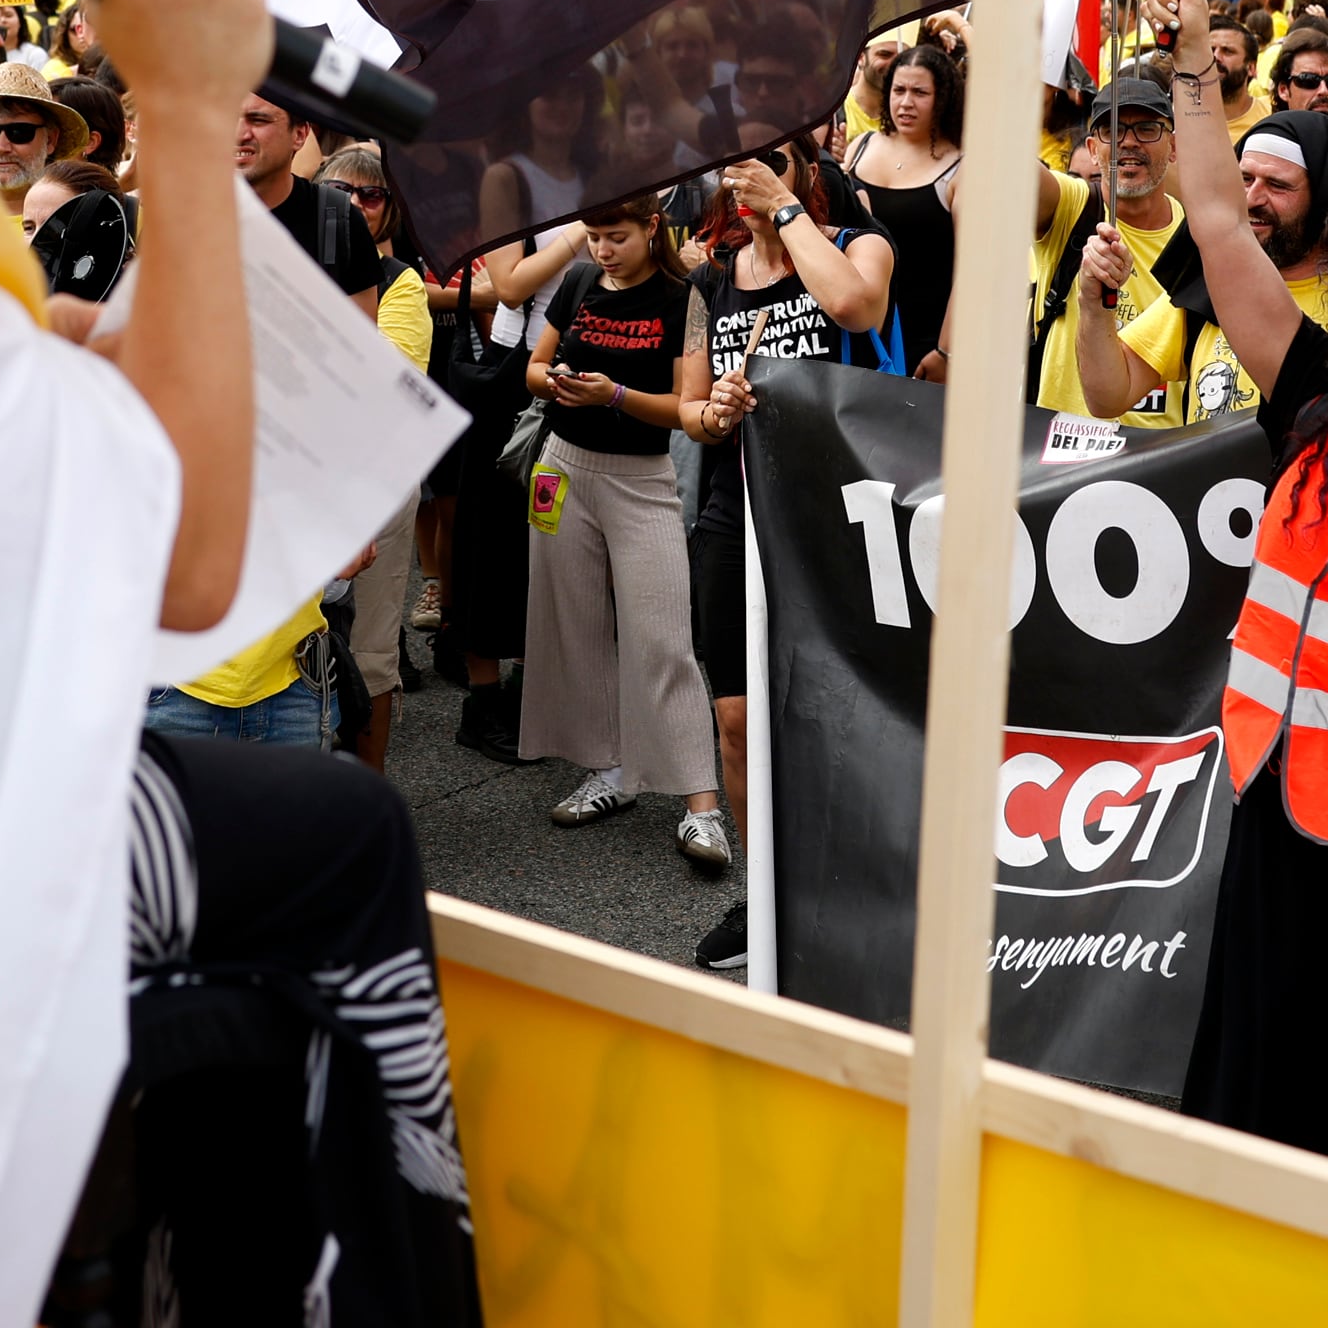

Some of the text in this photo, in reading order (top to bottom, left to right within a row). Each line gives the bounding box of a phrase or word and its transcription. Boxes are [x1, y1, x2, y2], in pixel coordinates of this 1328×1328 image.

[586, 315, 665, 336] CONTRA
[712, 314, 827, 350] L'ALTRNATIVA
[579, 330, 663, 350] CORRENT
[1051, 435, 1079, 451] DEL
[994, 752, 1207, 873] CGT
